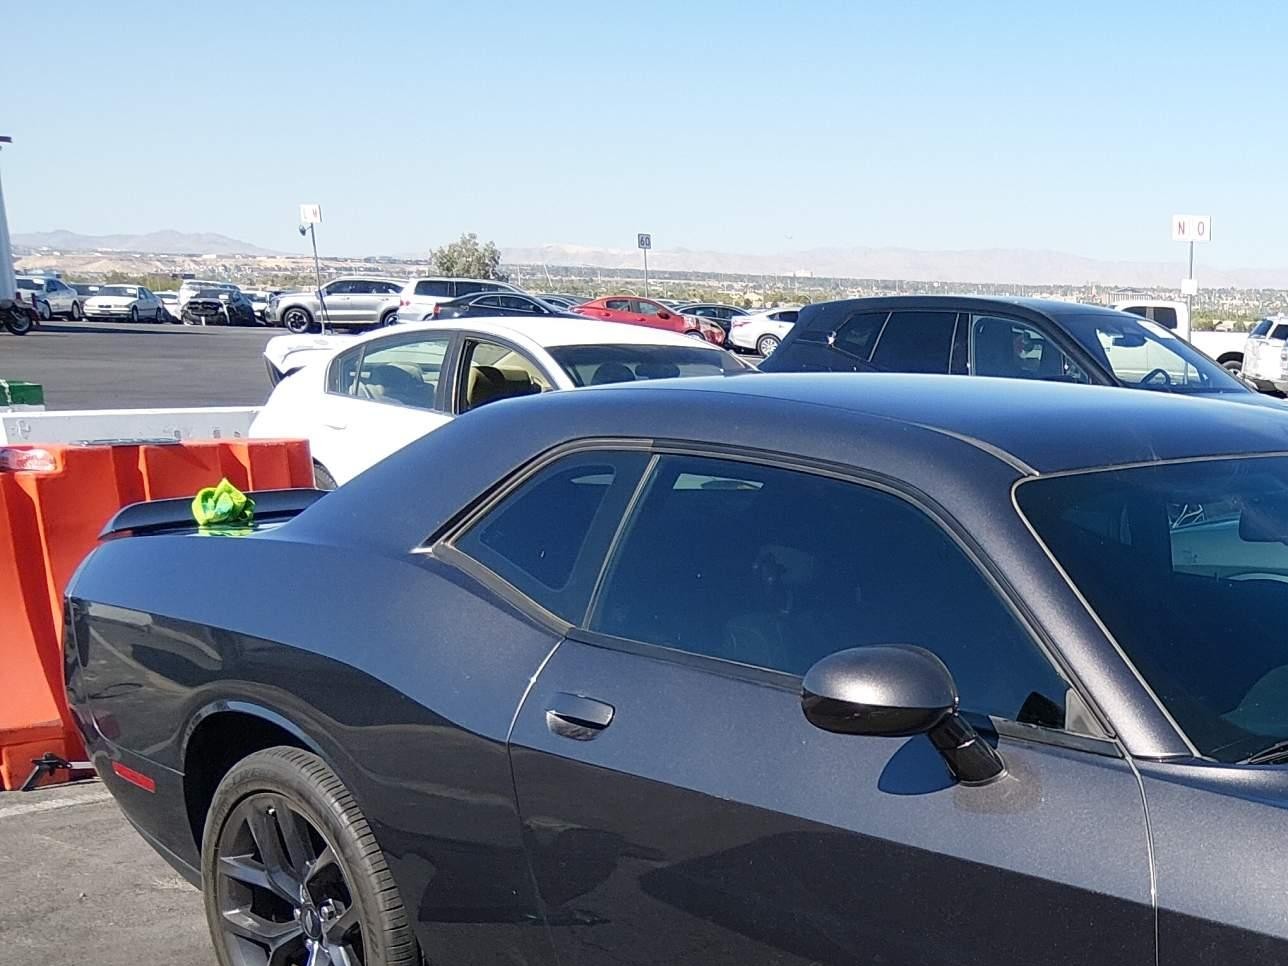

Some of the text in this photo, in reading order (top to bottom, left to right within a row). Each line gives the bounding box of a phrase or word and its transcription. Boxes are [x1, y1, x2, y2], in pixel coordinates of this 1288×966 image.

[1177, 220, 1205, 237] N O
[640, 236, 651, 247] 60
